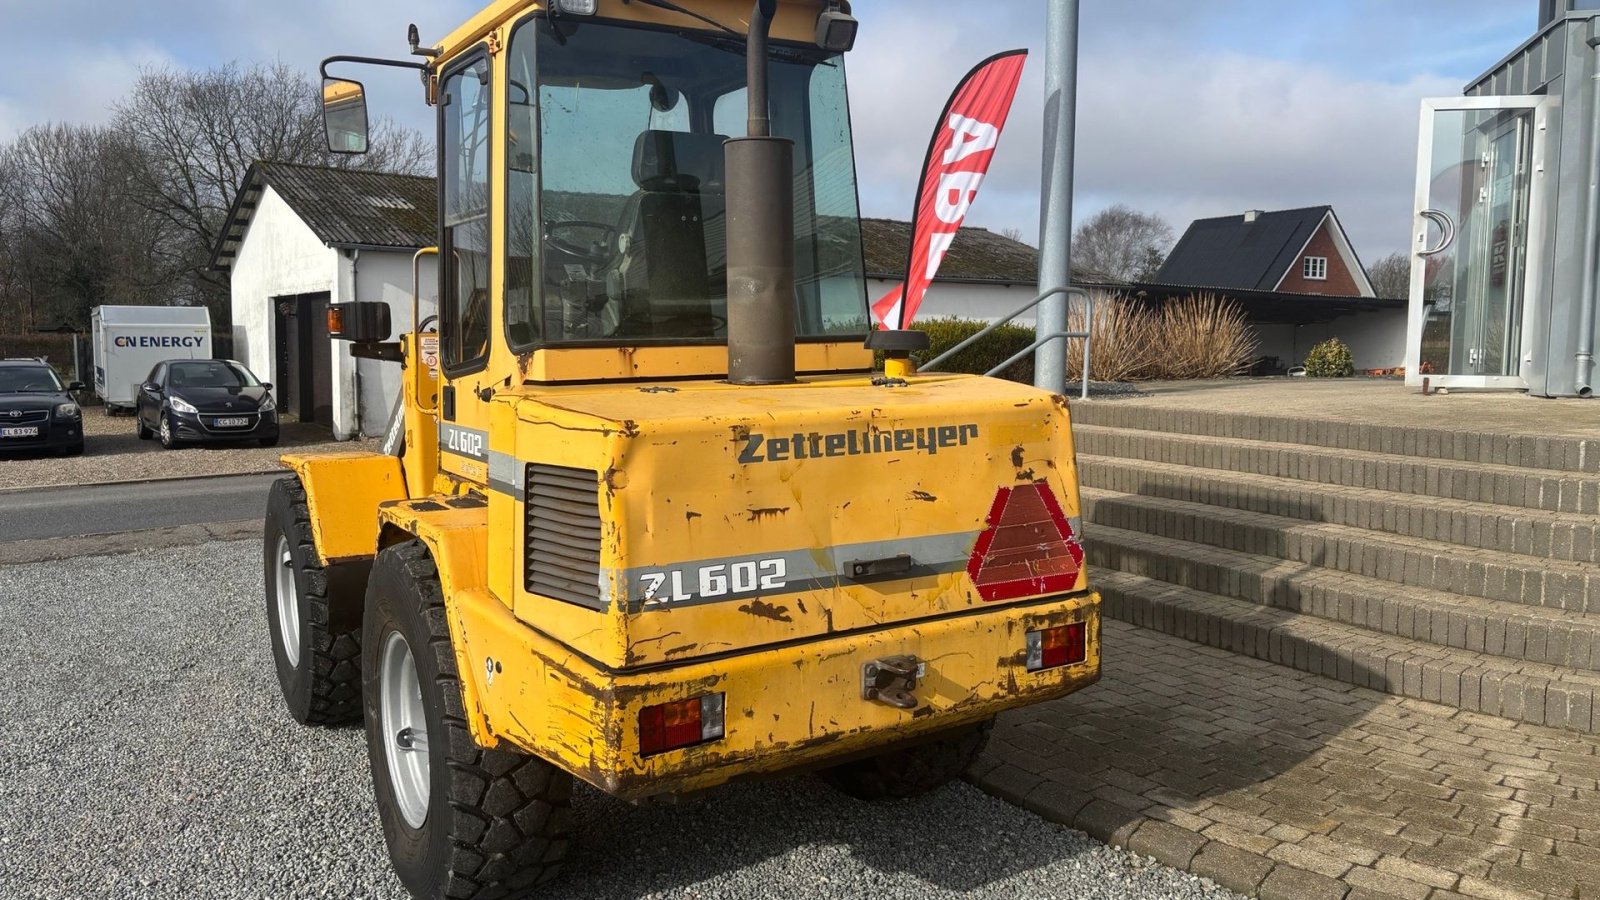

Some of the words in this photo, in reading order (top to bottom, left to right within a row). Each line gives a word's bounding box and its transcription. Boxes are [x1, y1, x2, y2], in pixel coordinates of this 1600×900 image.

[114, 336, 137, 347] CN
[140, 336, 203, 347] ENERGY
[448, 428, 460, 450] ZL
[460, 431, 482, 457] 602
[738, 423, 978, 464] Zettelmeyer
[640, 570, 691, 605] ZL
[698, 558, 786, 598] 602
